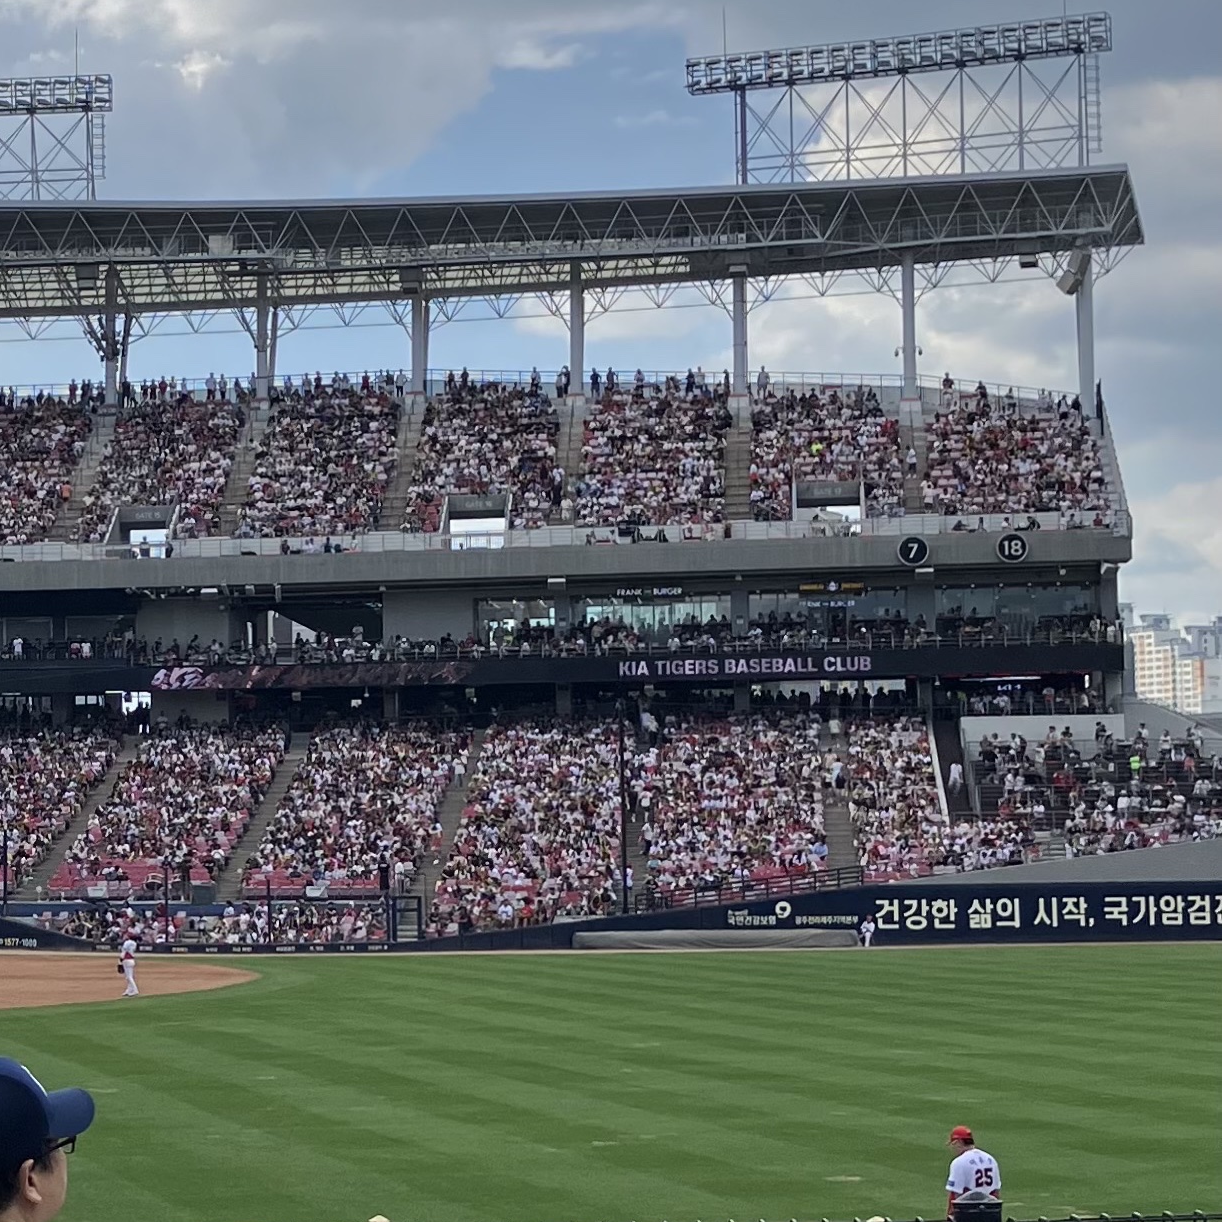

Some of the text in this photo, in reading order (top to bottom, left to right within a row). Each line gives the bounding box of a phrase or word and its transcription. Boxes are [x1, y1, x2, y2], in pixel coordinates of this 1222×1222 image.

[907, 543, 919, 558] 7
[1002, 540, 1023, 556] 18
[619, 655, 872, 676] KIA TIGERS BASEBALL CLUB
[875, 898, 958, 930] 건강한
[967, 897, 1021, 929] 삶의
[1033, 896, 1095, 928] 시작,
[975, 1167, 993, 1188] 25
